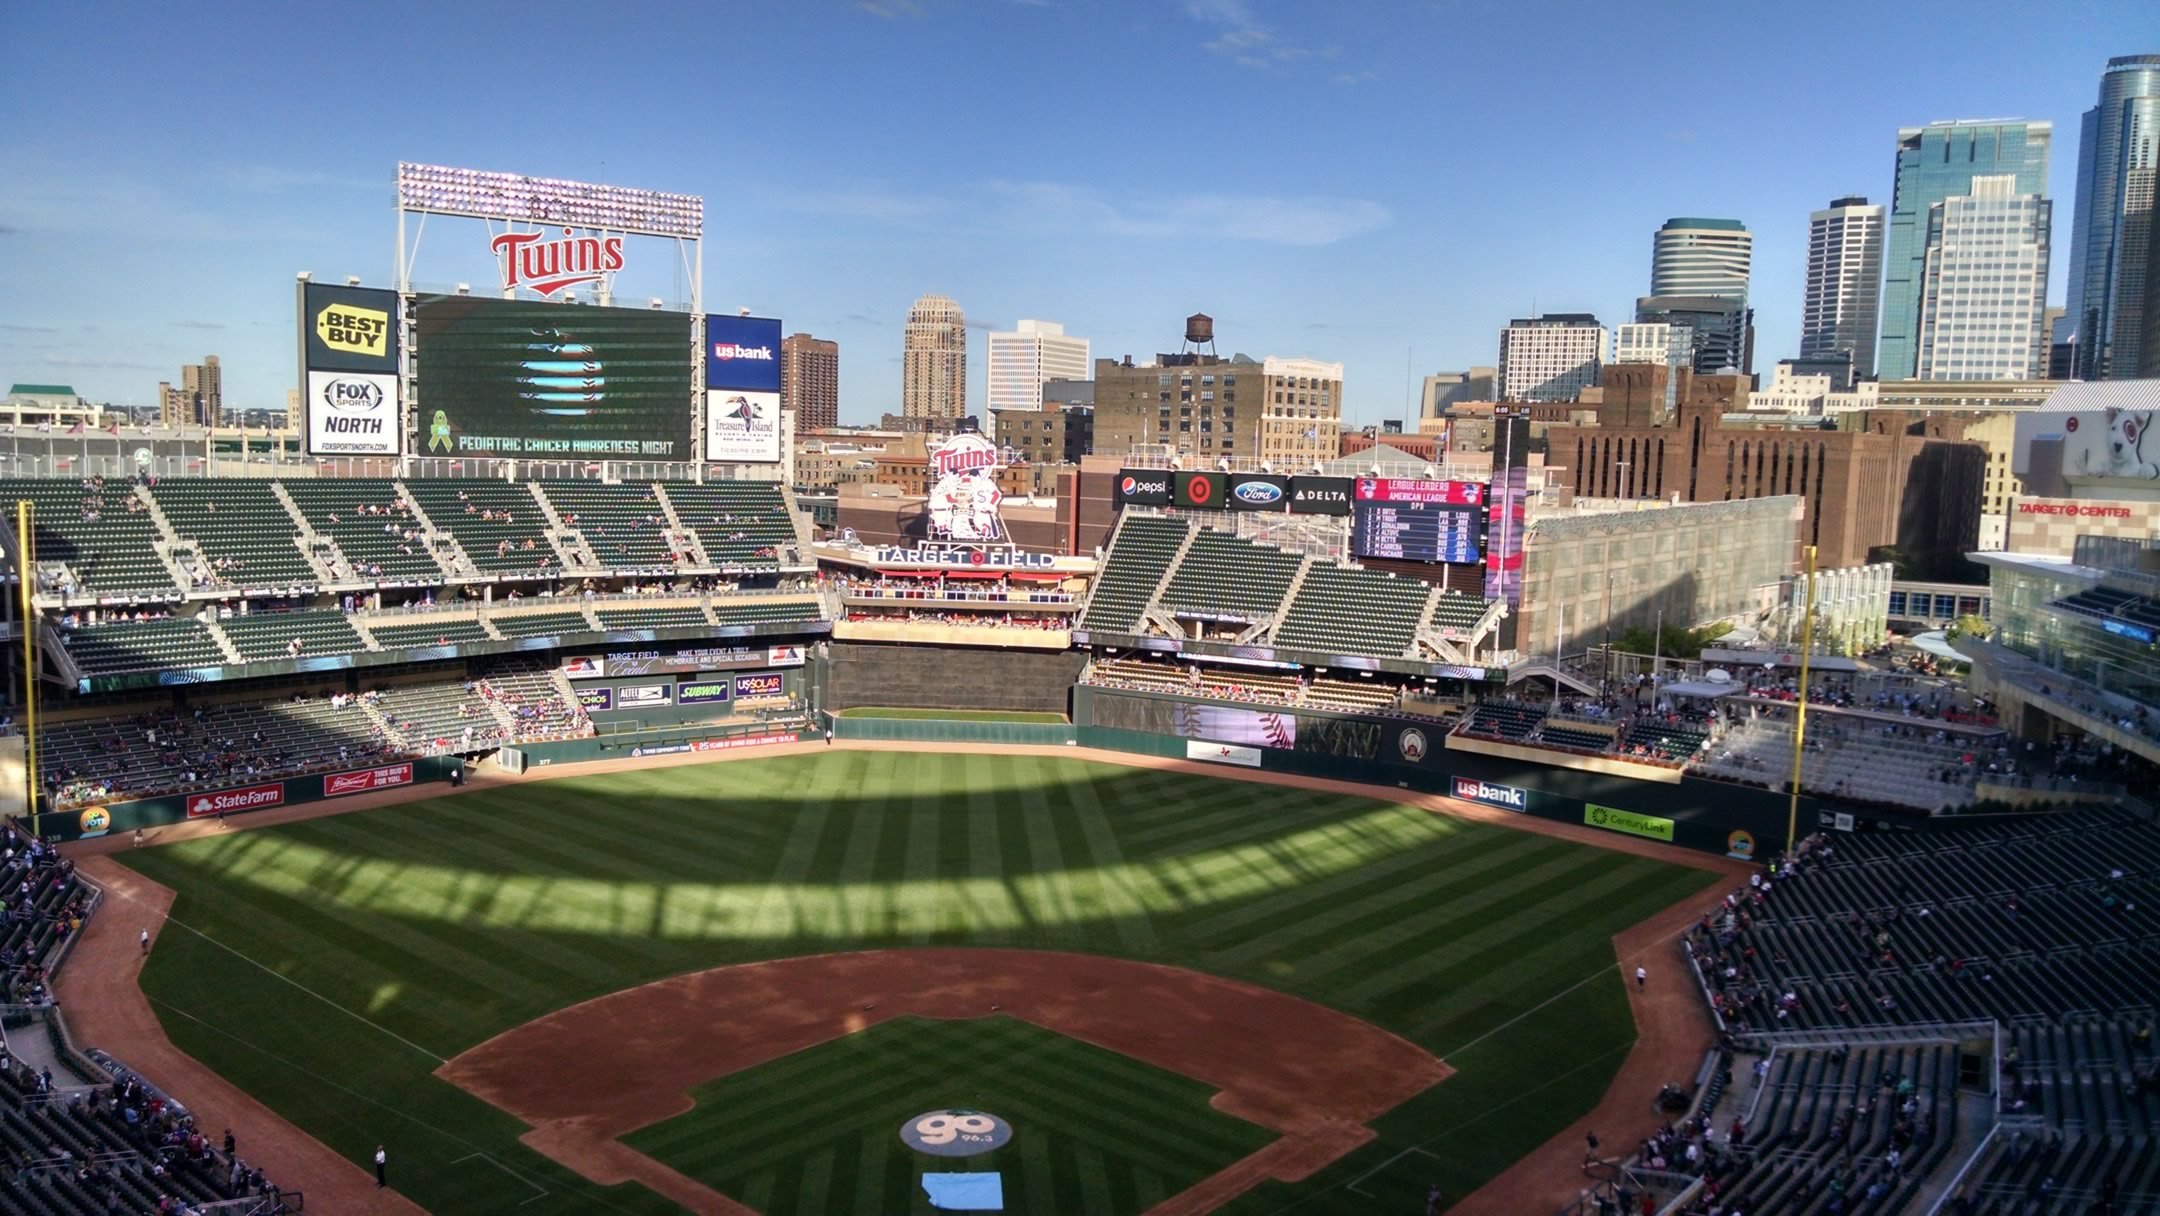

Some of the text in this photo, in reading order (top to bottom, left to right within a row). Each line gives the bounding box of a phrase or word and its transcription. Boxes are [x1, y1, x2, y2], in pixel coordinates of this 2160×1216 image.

[491, 227, 625, 288] Twins
[327, 312, 385, 334] BEST
[328, 327, 380, 348] BUY
[336, 383, 370, 400] FOX
[325, 416, 382, 434] NORTH
[715, 419, 773, 432] Treasure Island
[322, 442, 388, 451] FOXSPORTSNORTH.COM
[459, 436, 674, 454] PEDIATRIC CANCER AWARENESS NIGHT
[932, 446, 997, 478] Twins
[1136, 481, 1166, 493] pepsi
[1243, 482, 1273, 500] Ford
[1388, 480, 1449, 491] LEAGUE LEADERS
[1308, 490, 1346, 501] DELTA
[1389, 492, 1448, 502] AMERICAN LEAGUE
[2018, 504, 2131, 518] TARGET CENTER
[880, 551, 1055, 567] TARGET FIELD
[1380, 550, 1403, 558] MACHADO
[607, 651, 659, 661] TARGET FIELD
[677, 649, 693, 657] MAKE
[665, 656, 698, 665] MEMORABLE
[700, 655, 711, 663] AND
[712, 654, 733, 662] SPECIAL
[680, 684, 726, 698] SUBWAY
[698, 742, 709, 751] 25
[539, 758, 551, 766] 377
[374, 766, 408, 777] THIS BUD'S
[374, 778, 387, 786] FOR
[83, 817, 106, 827] VOTE
[1610, 814, 1667, 834] CenturyLink
[961, 1134, 993, 1142] 96.3
